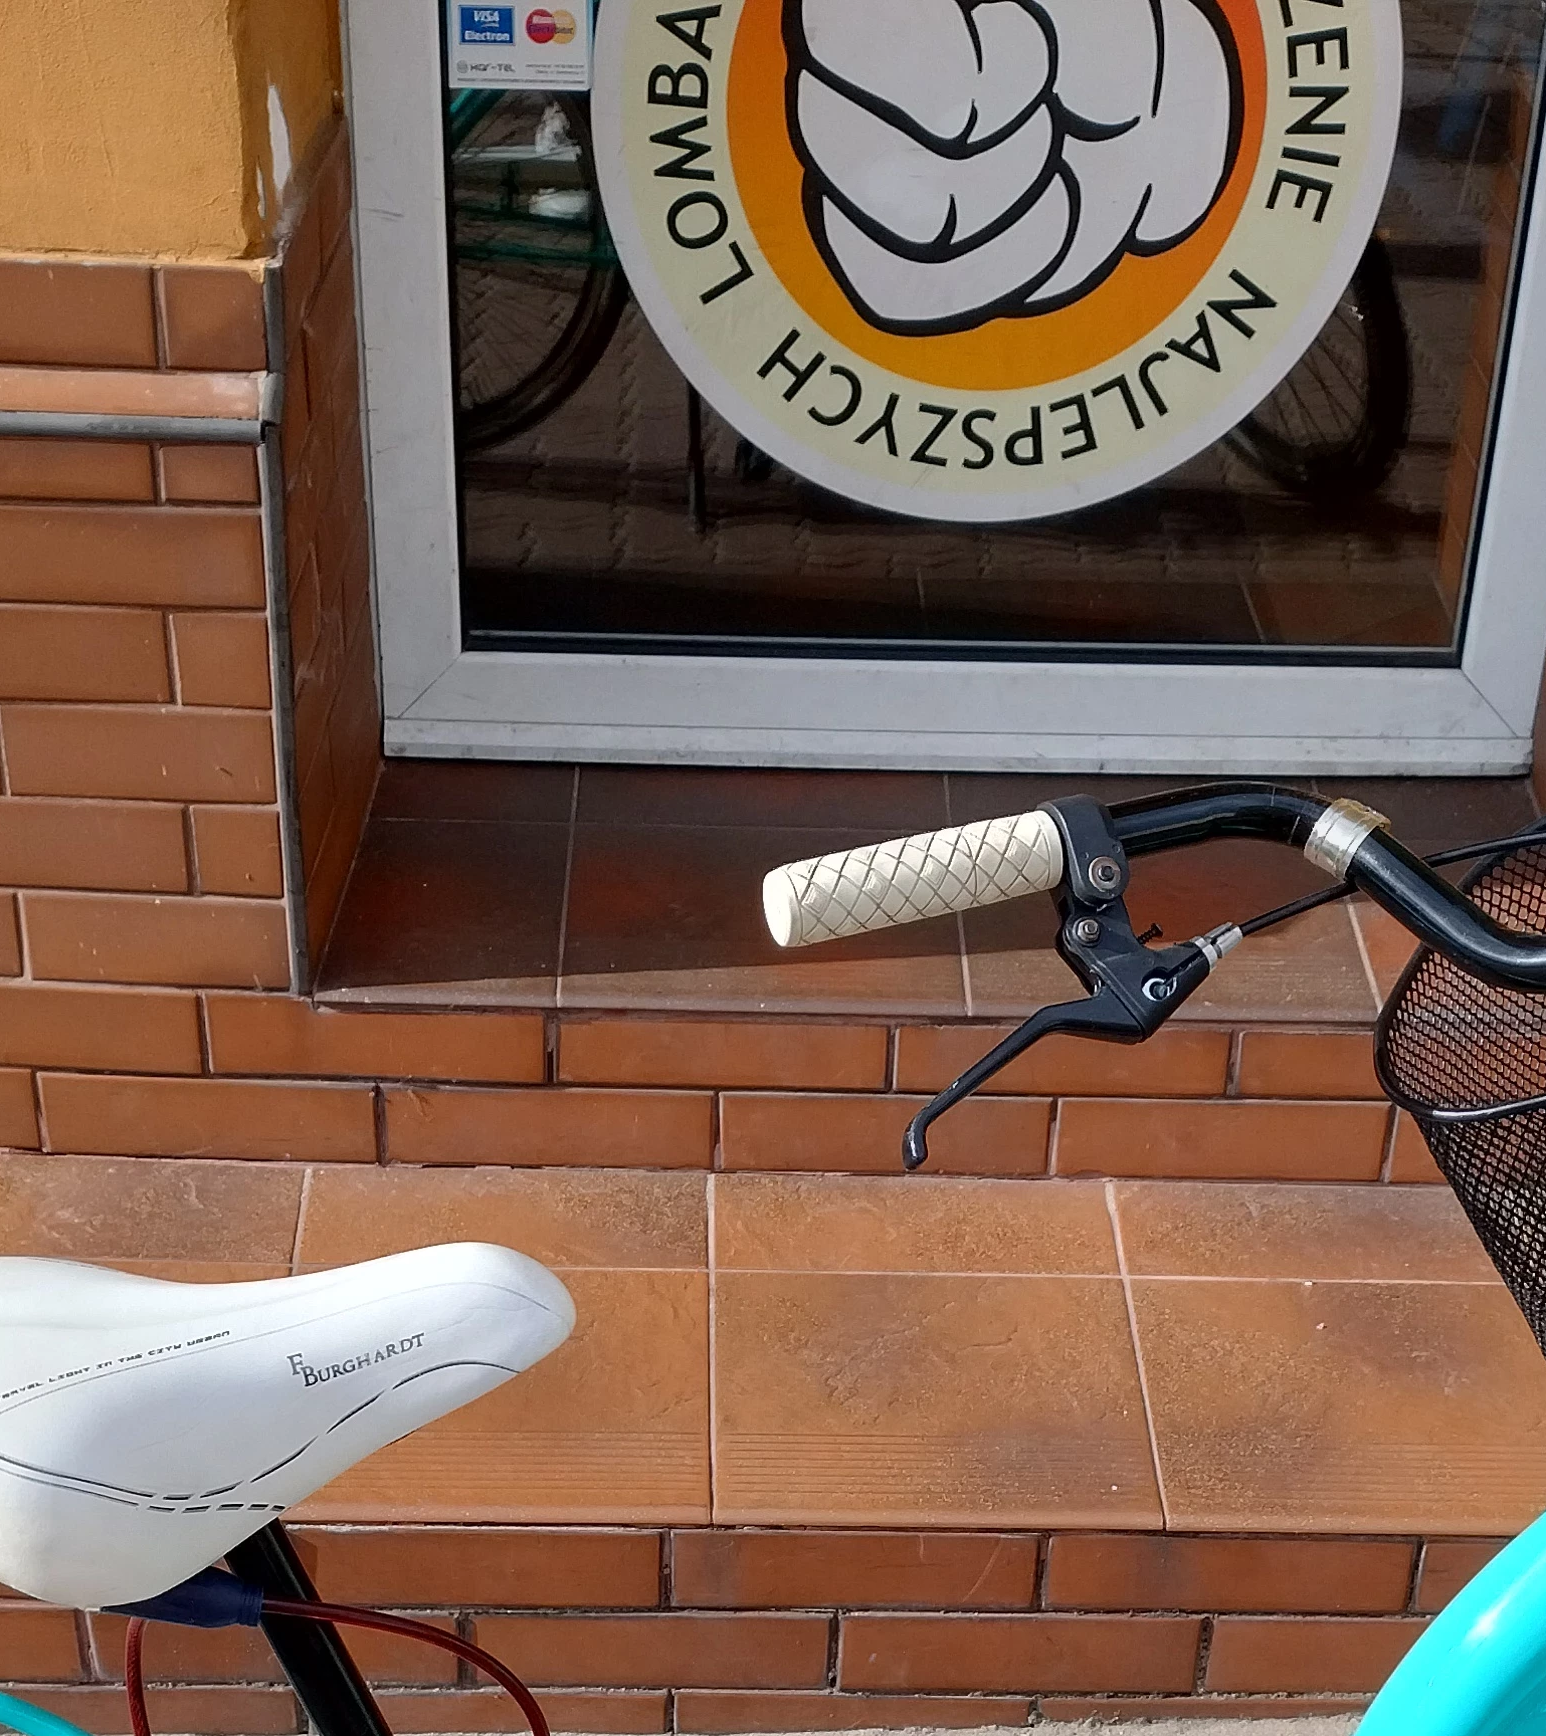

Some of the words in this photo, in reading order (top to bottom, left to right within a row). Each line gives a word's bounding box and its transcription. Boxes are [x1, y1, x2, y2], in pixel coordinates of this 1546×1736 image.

[464, 30, 510, 41] Electron
[474, 10, 500, 22] VISA
[646, 4, 755, 305] LOMBA
[755, 268, 1278, 470] NAJLEPSZYCH
